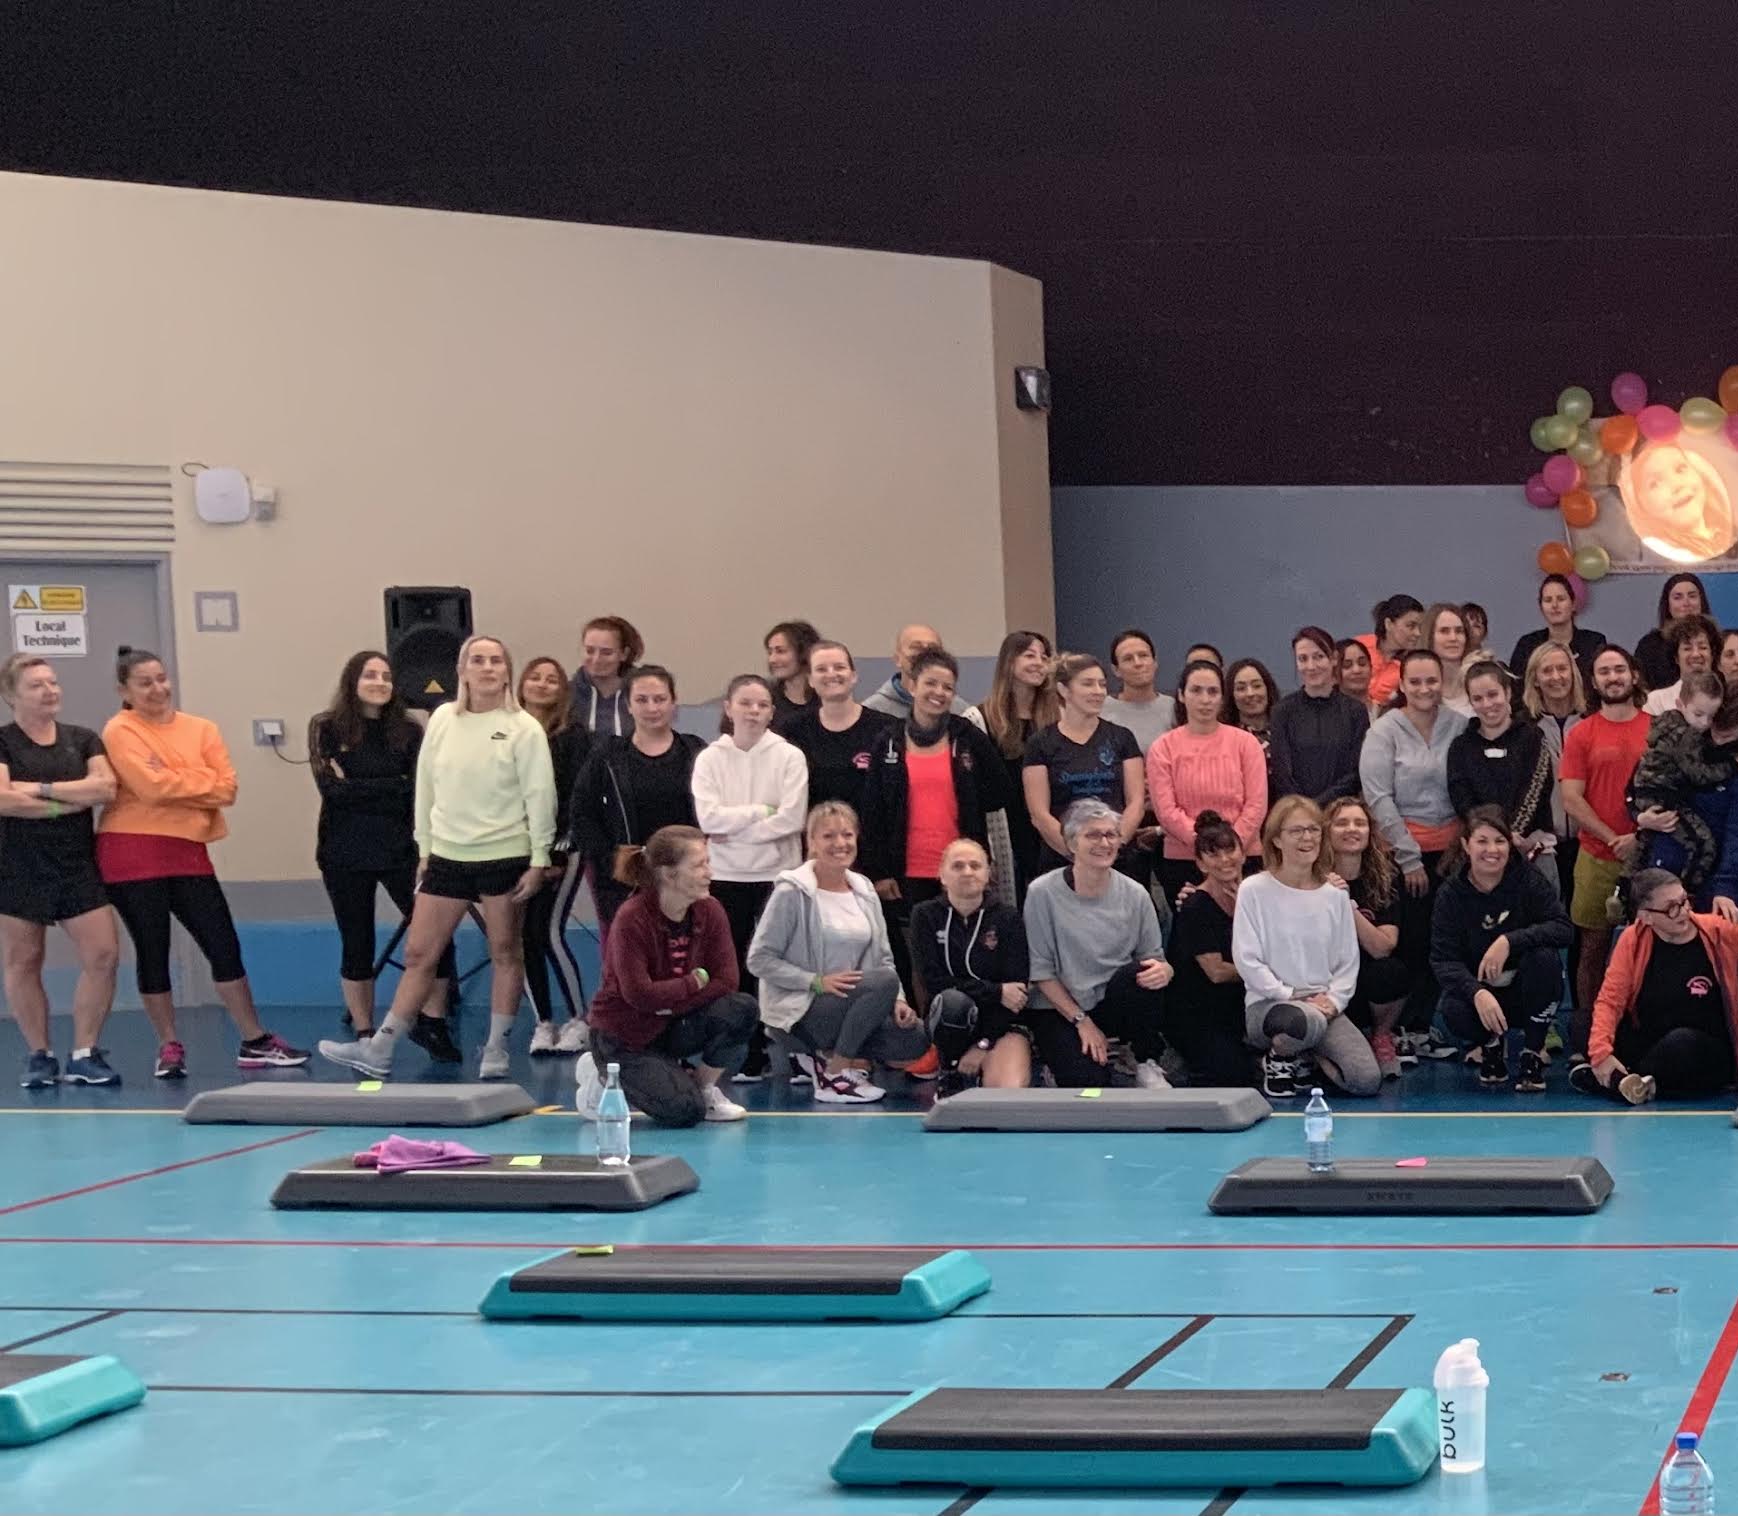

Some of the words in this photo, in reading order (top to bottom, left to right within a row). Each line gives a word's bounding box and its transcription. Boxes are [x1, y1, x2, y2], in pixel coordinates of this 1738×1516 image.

[35, 621, 66, 632] Local
[23, 634, 82, 647] Technique
[1440, 1401, 1457, 1460] bulk
